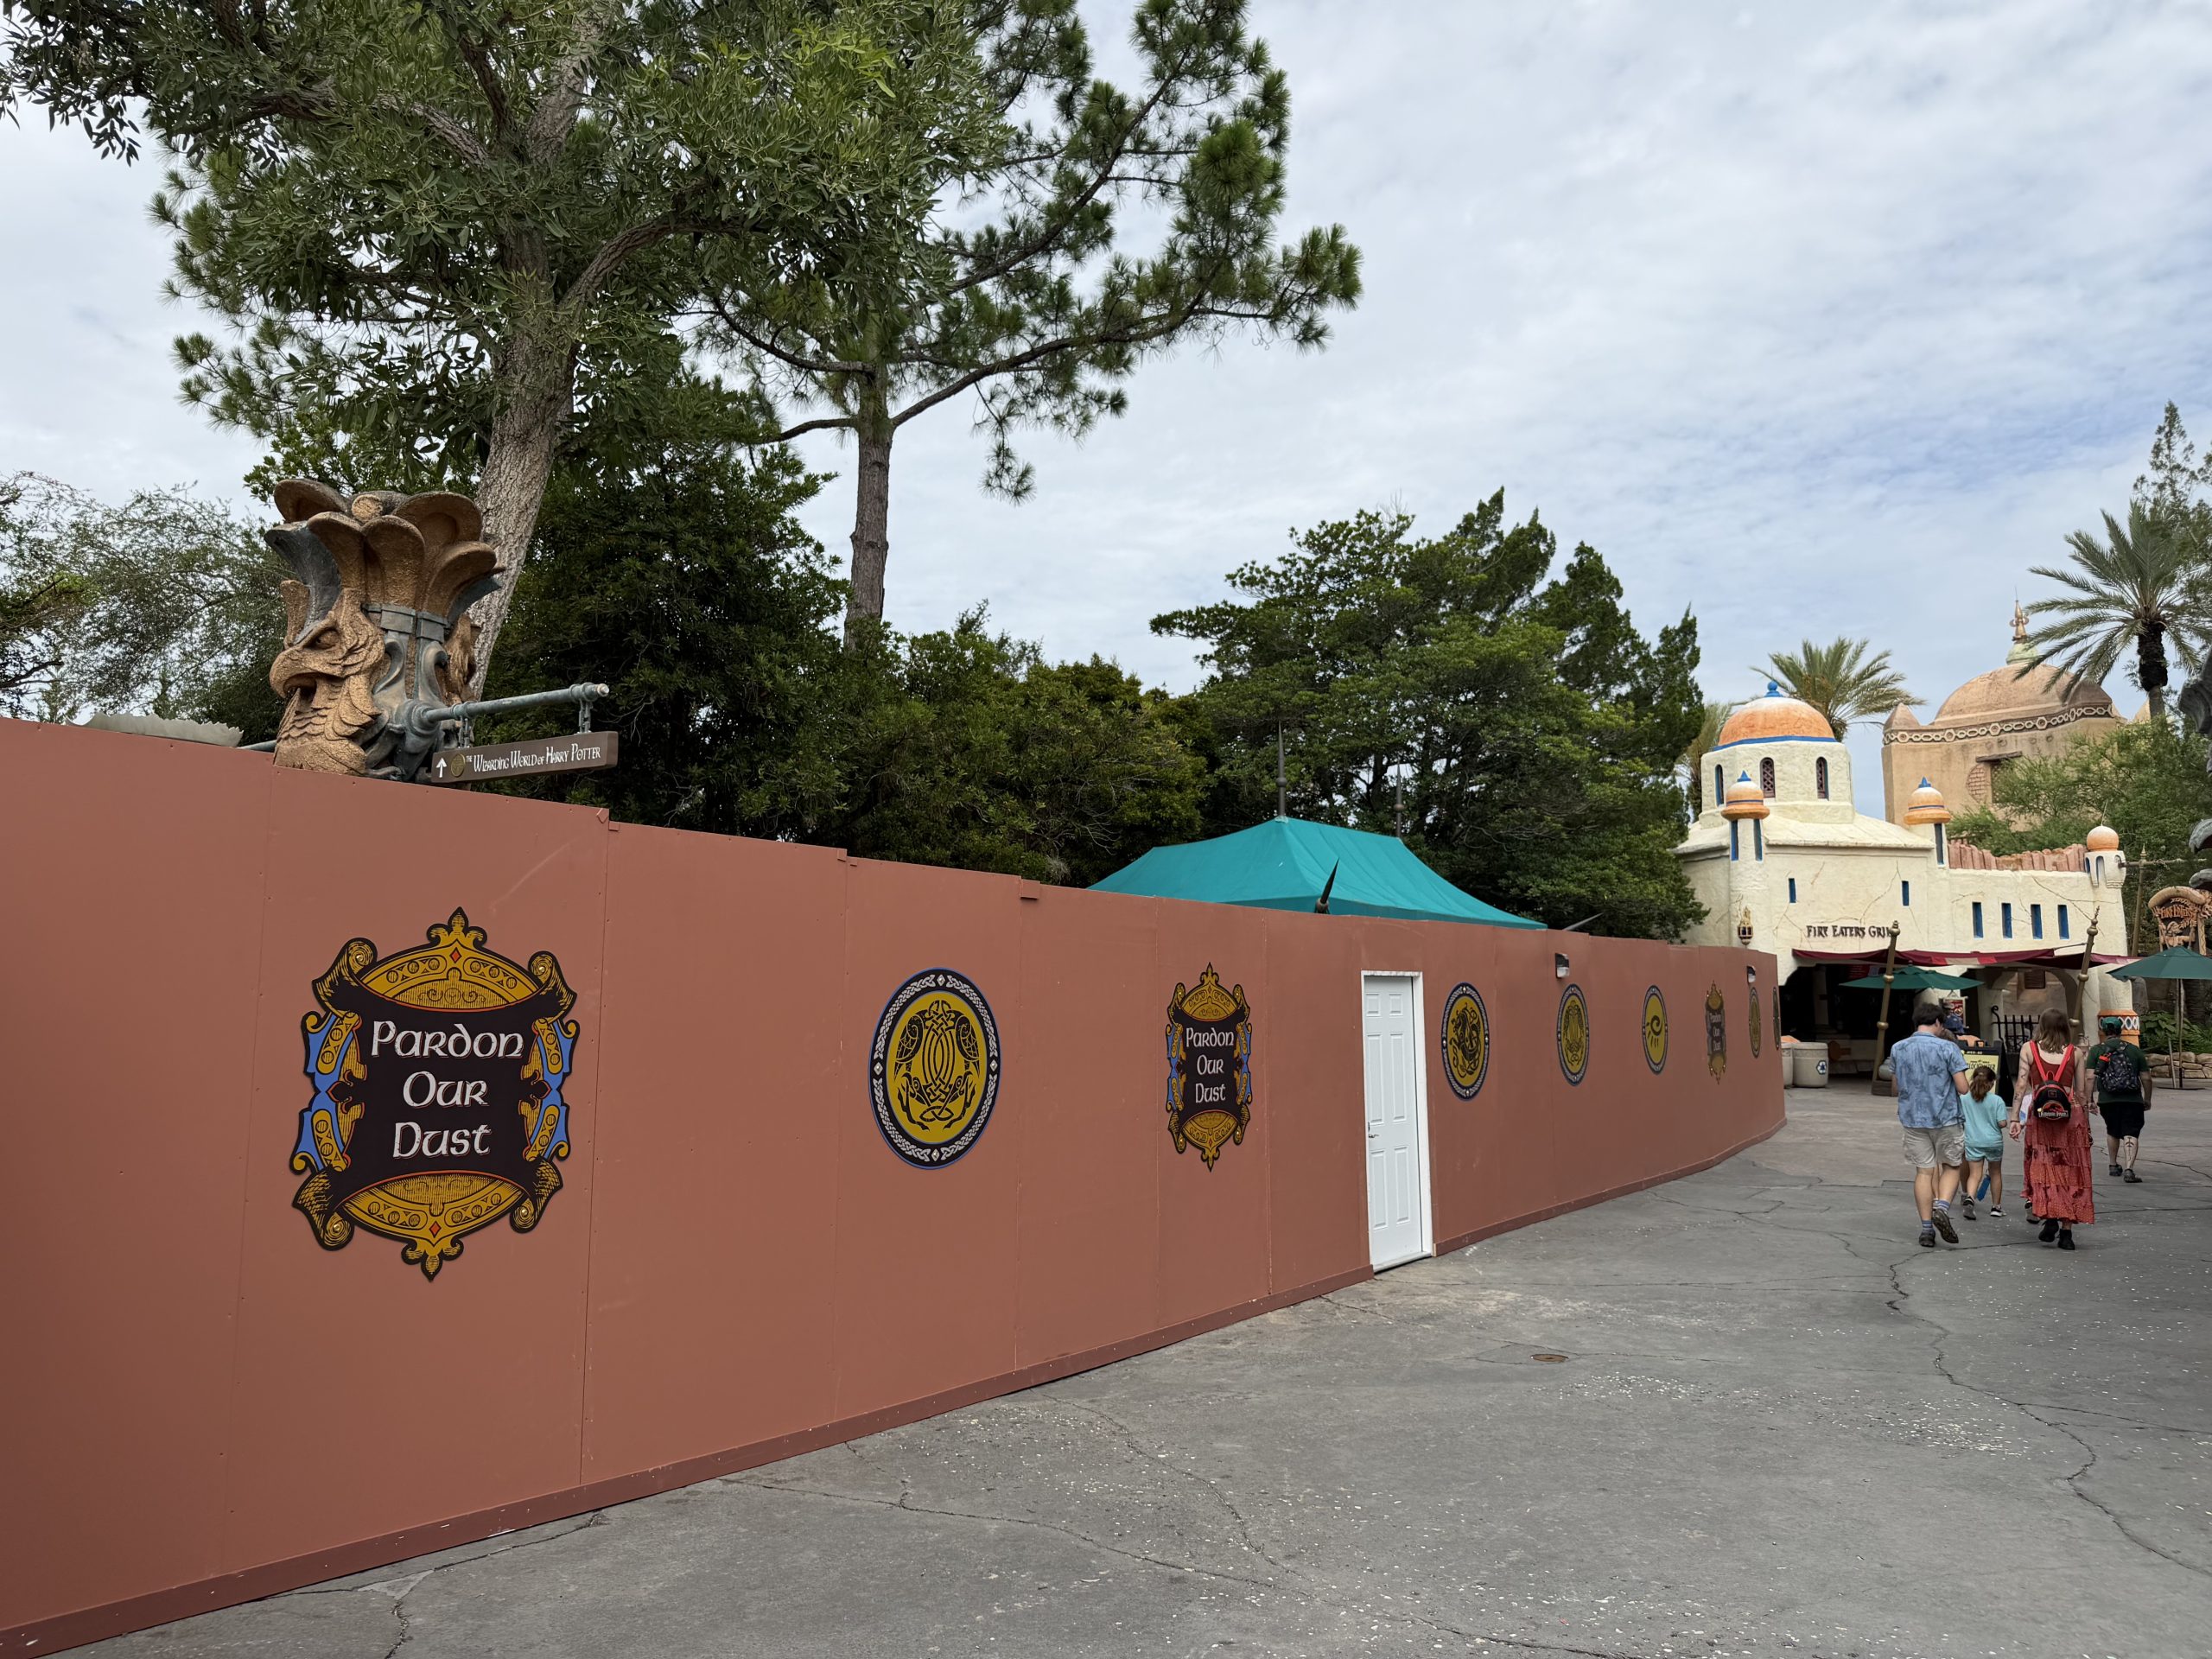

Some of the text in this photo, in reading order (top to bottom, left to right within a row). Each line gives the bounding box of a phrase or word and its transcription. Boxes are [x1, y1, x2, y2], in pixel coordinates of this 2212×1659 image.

[511, 750, 537, 767] WORLD
[546, 746, 569, 765] HARRY
[571, 743, 601, 761] POTTER
[1806, 925, 1828, 938] FIRE
[372, 1020, 524, 1058] Pardon
[1185, 1027, 1235, 1047] Pardon
[1197, 1054, 1224, 1075] Our
[403, 1071, 489, 1108] Our
[1195, 1083, 1226, 1103] Dust
[392, 1122, 492, 1159] Dust
